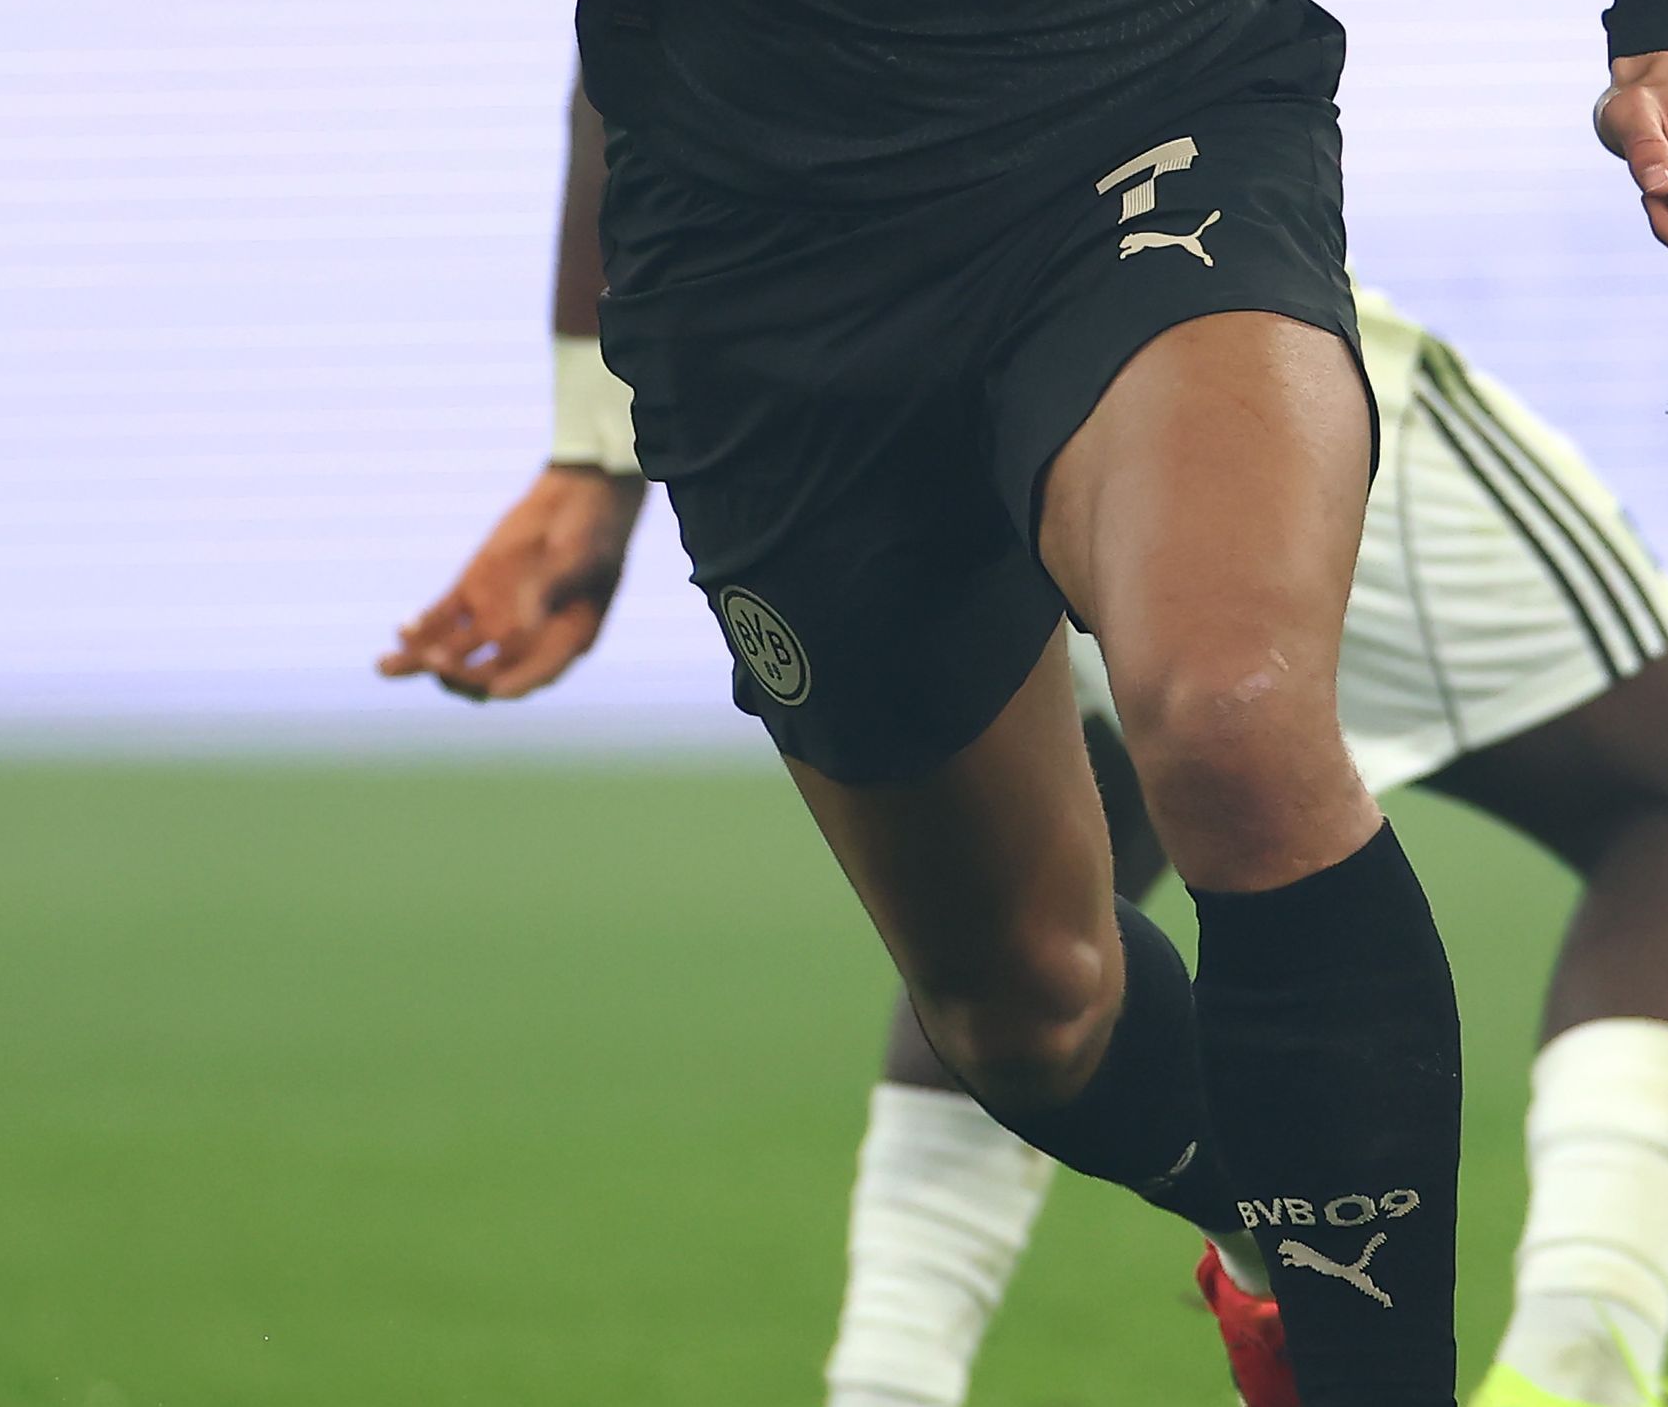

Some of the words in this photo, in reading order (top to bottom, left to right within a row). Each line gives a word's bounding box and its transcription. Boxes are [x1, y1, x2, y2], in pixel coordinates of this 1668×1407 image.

[1095, 136, 1199, 225] 7
[735, 609, 792, 666] BVB
[1237, 1197, 1316, 1229] BVB
[1323, 1189, 1420, 1227] 09
